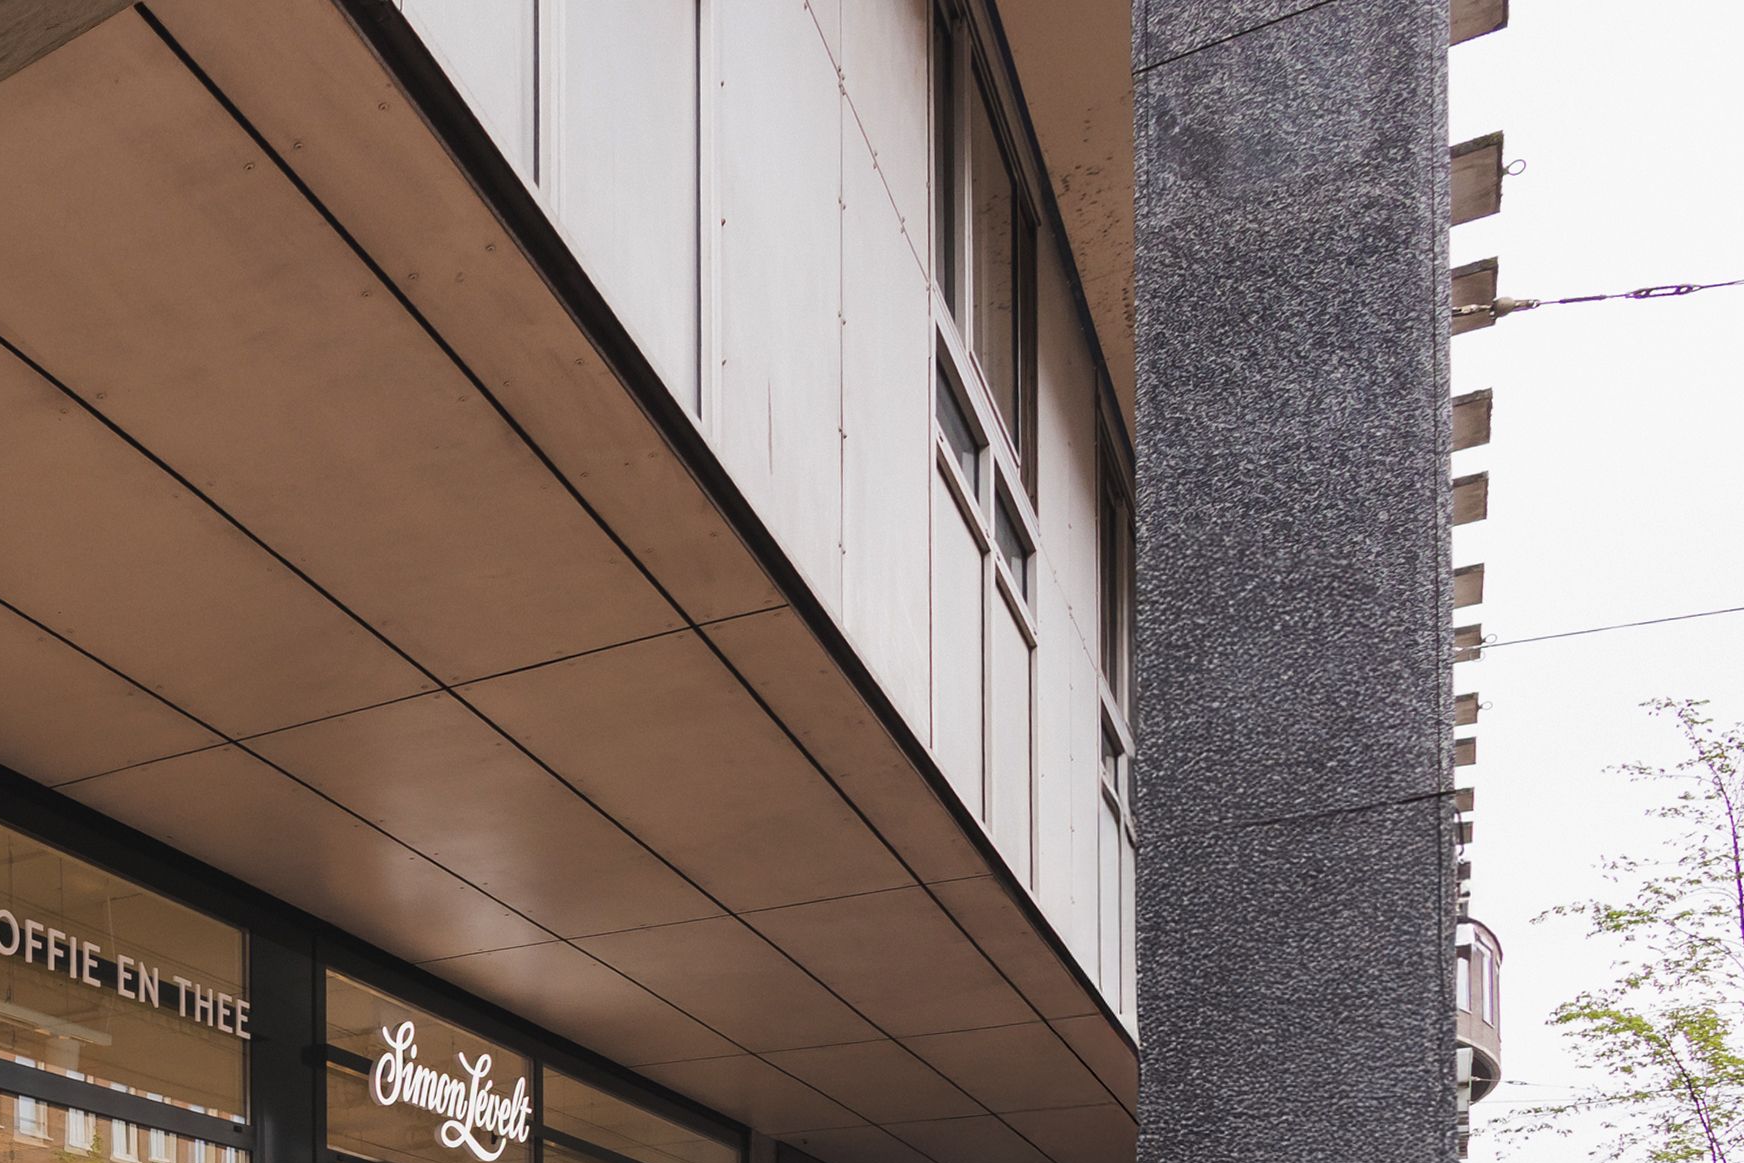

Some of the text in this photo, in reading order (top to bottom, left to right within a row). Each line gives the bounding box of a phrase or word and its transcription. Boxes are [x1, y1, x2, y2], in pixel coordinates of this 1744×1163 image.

[117, 953, 160, 1009] EN
[173, 975, 252, 1040] THEE
[370, 1020, 533, 1162] Simon Lévelt
